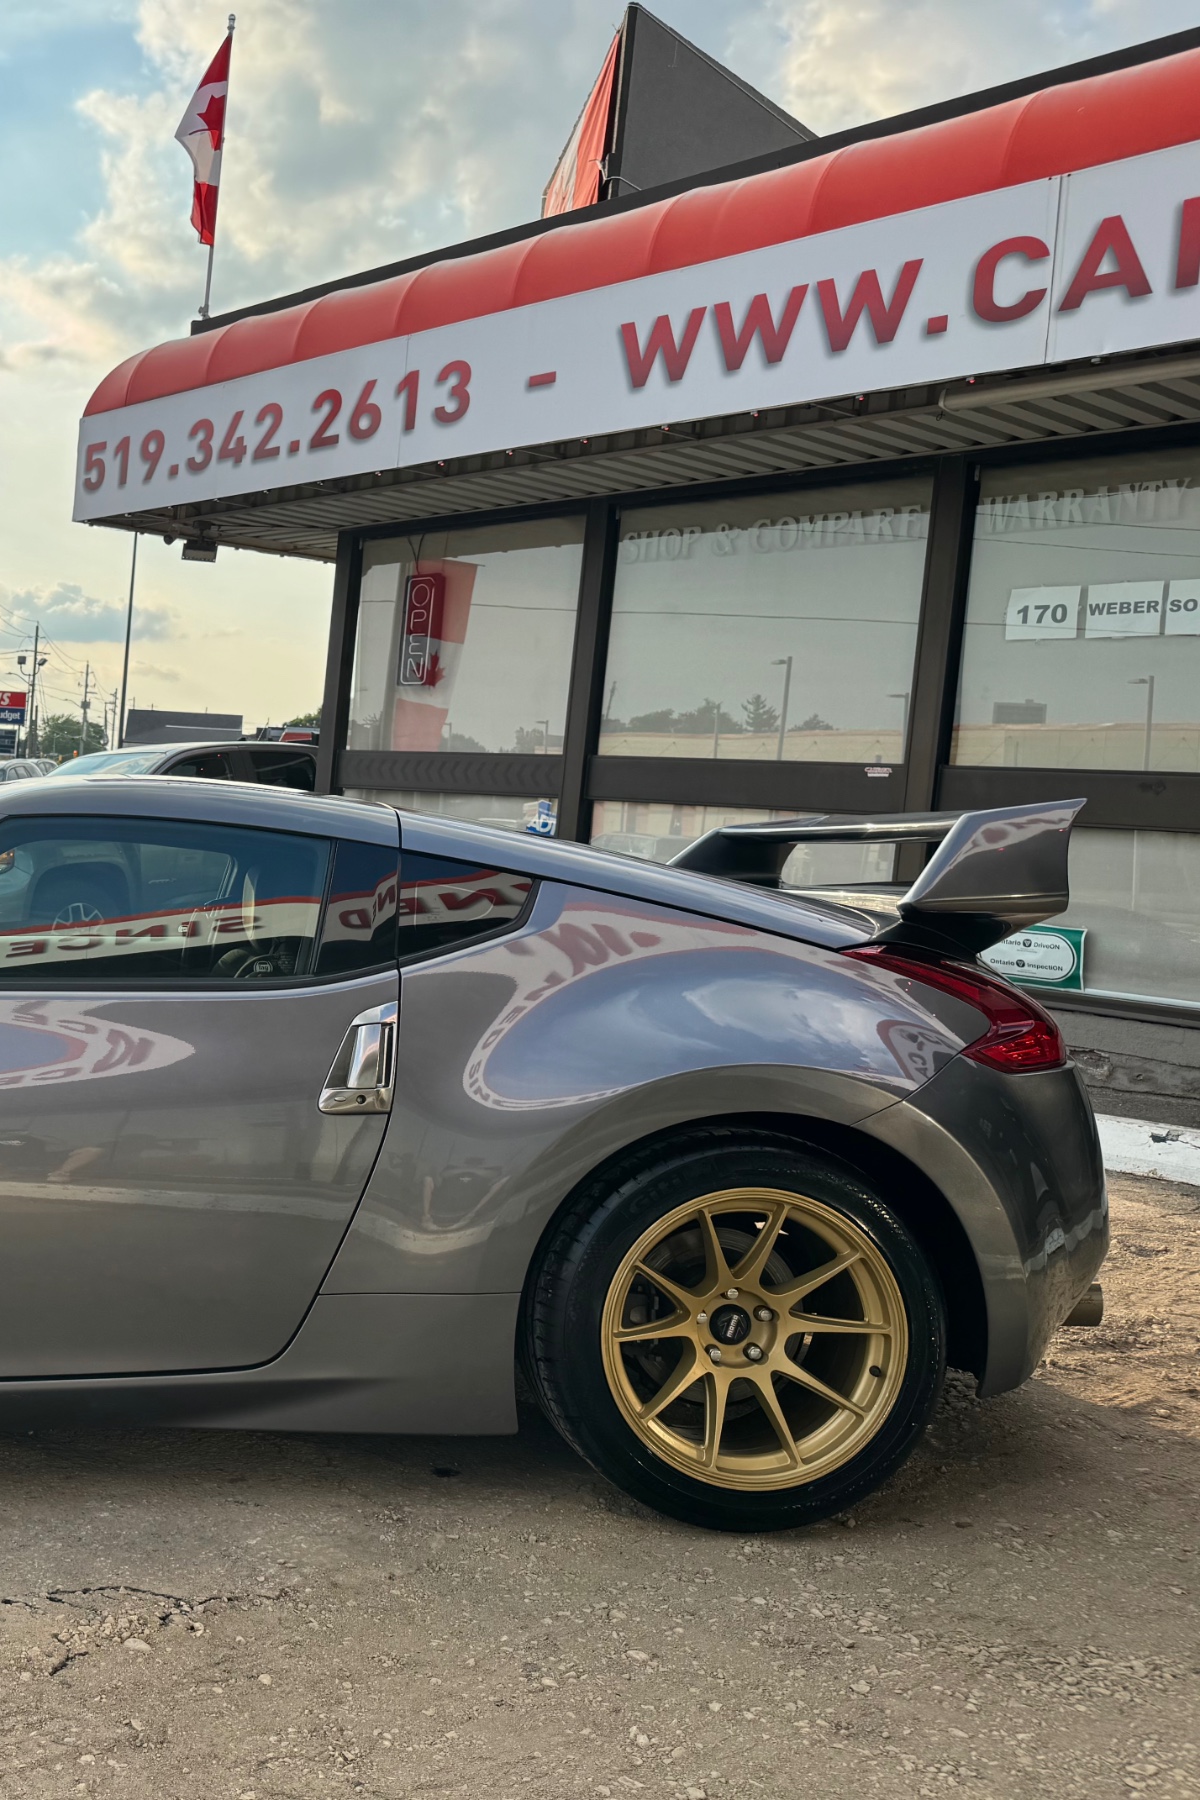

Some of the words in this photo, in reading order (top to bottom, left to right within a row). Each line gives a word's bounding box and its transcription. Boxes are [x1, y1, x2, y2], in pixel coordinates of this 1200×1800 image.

[83, 359, 472, 490] 519.342.2613
[622, 525, 702, 564] SHOP
[712, 522, 742, 556] &
[982, 477, 1192, 534] WARRANTY
[406, 583, 430, 678] OPEN
[1016, 603, 1068, 625] 170
[1088, 600, 1160, 616] WEBER
[1168, 598, 1199, 613] SO
[989, 958, 1015, 966] Ontario
